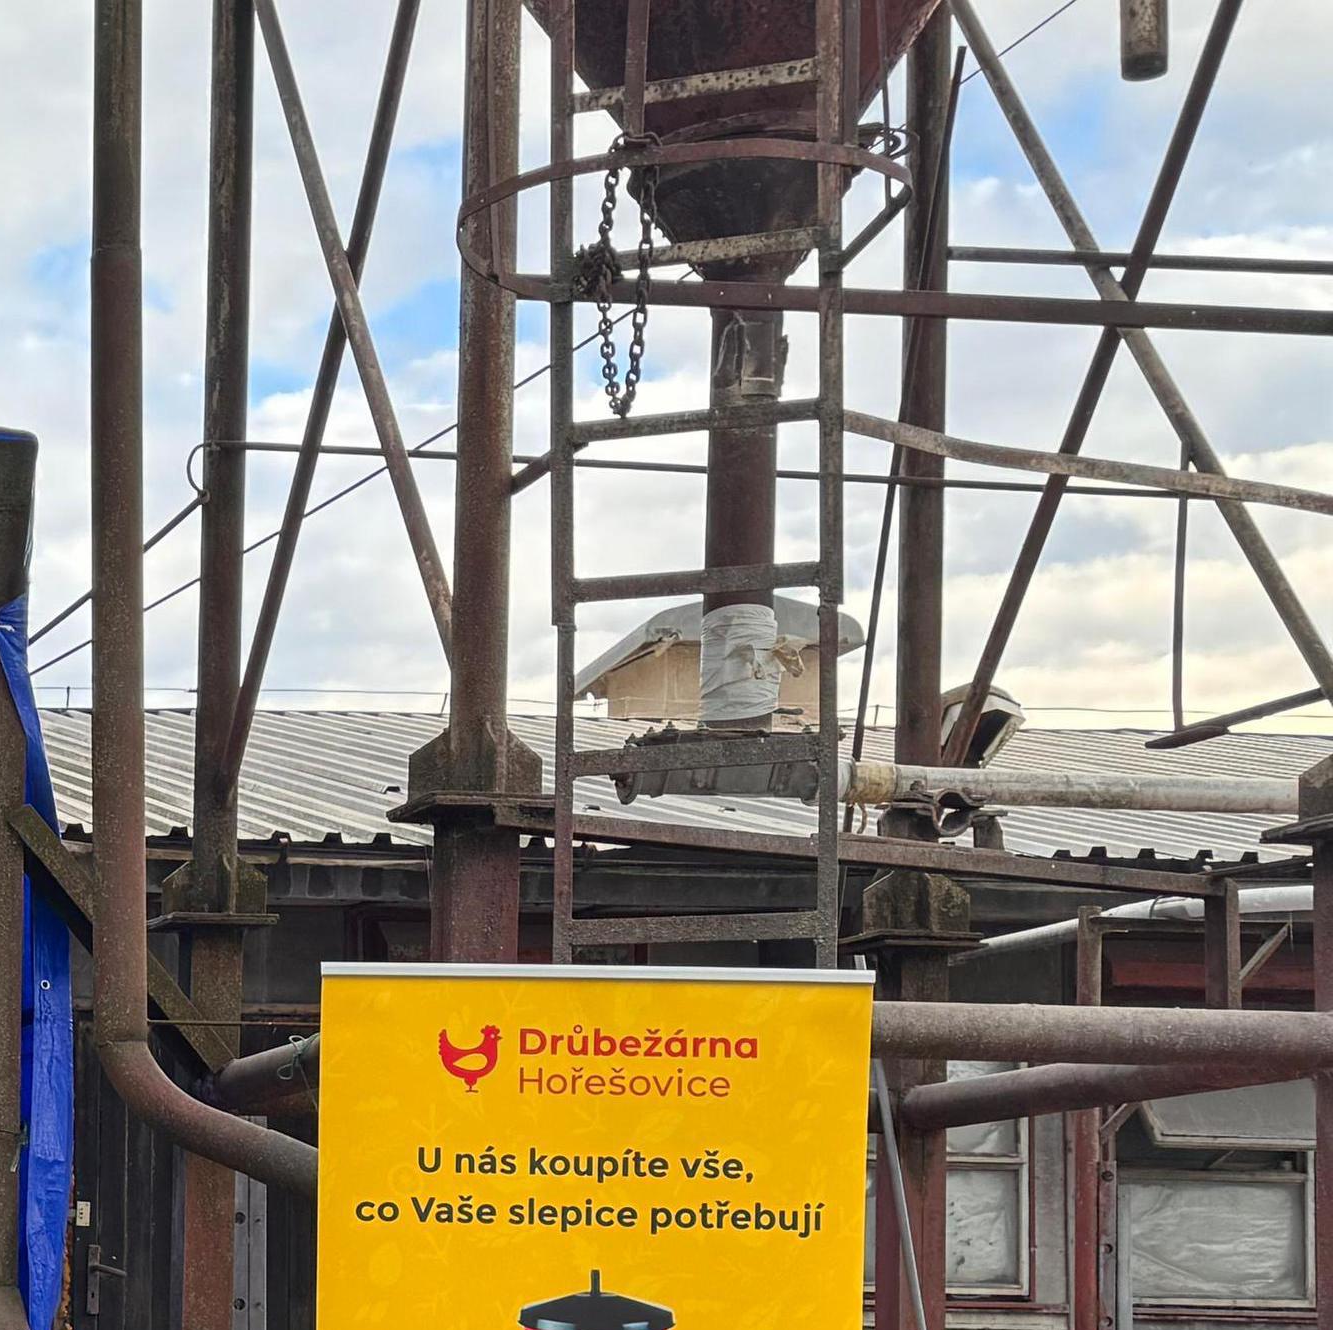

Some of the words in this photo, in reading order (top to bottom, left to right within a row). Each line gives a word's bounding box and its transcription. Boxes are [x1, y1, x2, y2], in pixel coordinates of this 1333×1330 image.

[520, 1025, 757, 1058] Drůbežárna
[520, 1067, 730, 1097] Hořešovice
[419, 1147, 441, 1173] U
[456, 1146, 516, 1174] nás
[530, 1148, 668, 1183] koupíte
[680, 1150, 753, 1182] vše,
[356, 1202, 399, 1221] co
[411, 1195, 496, 1224] Vaše
[509, 1198, 637, 1232] slepice
[651, 1201, 825, 1238] potřebují
